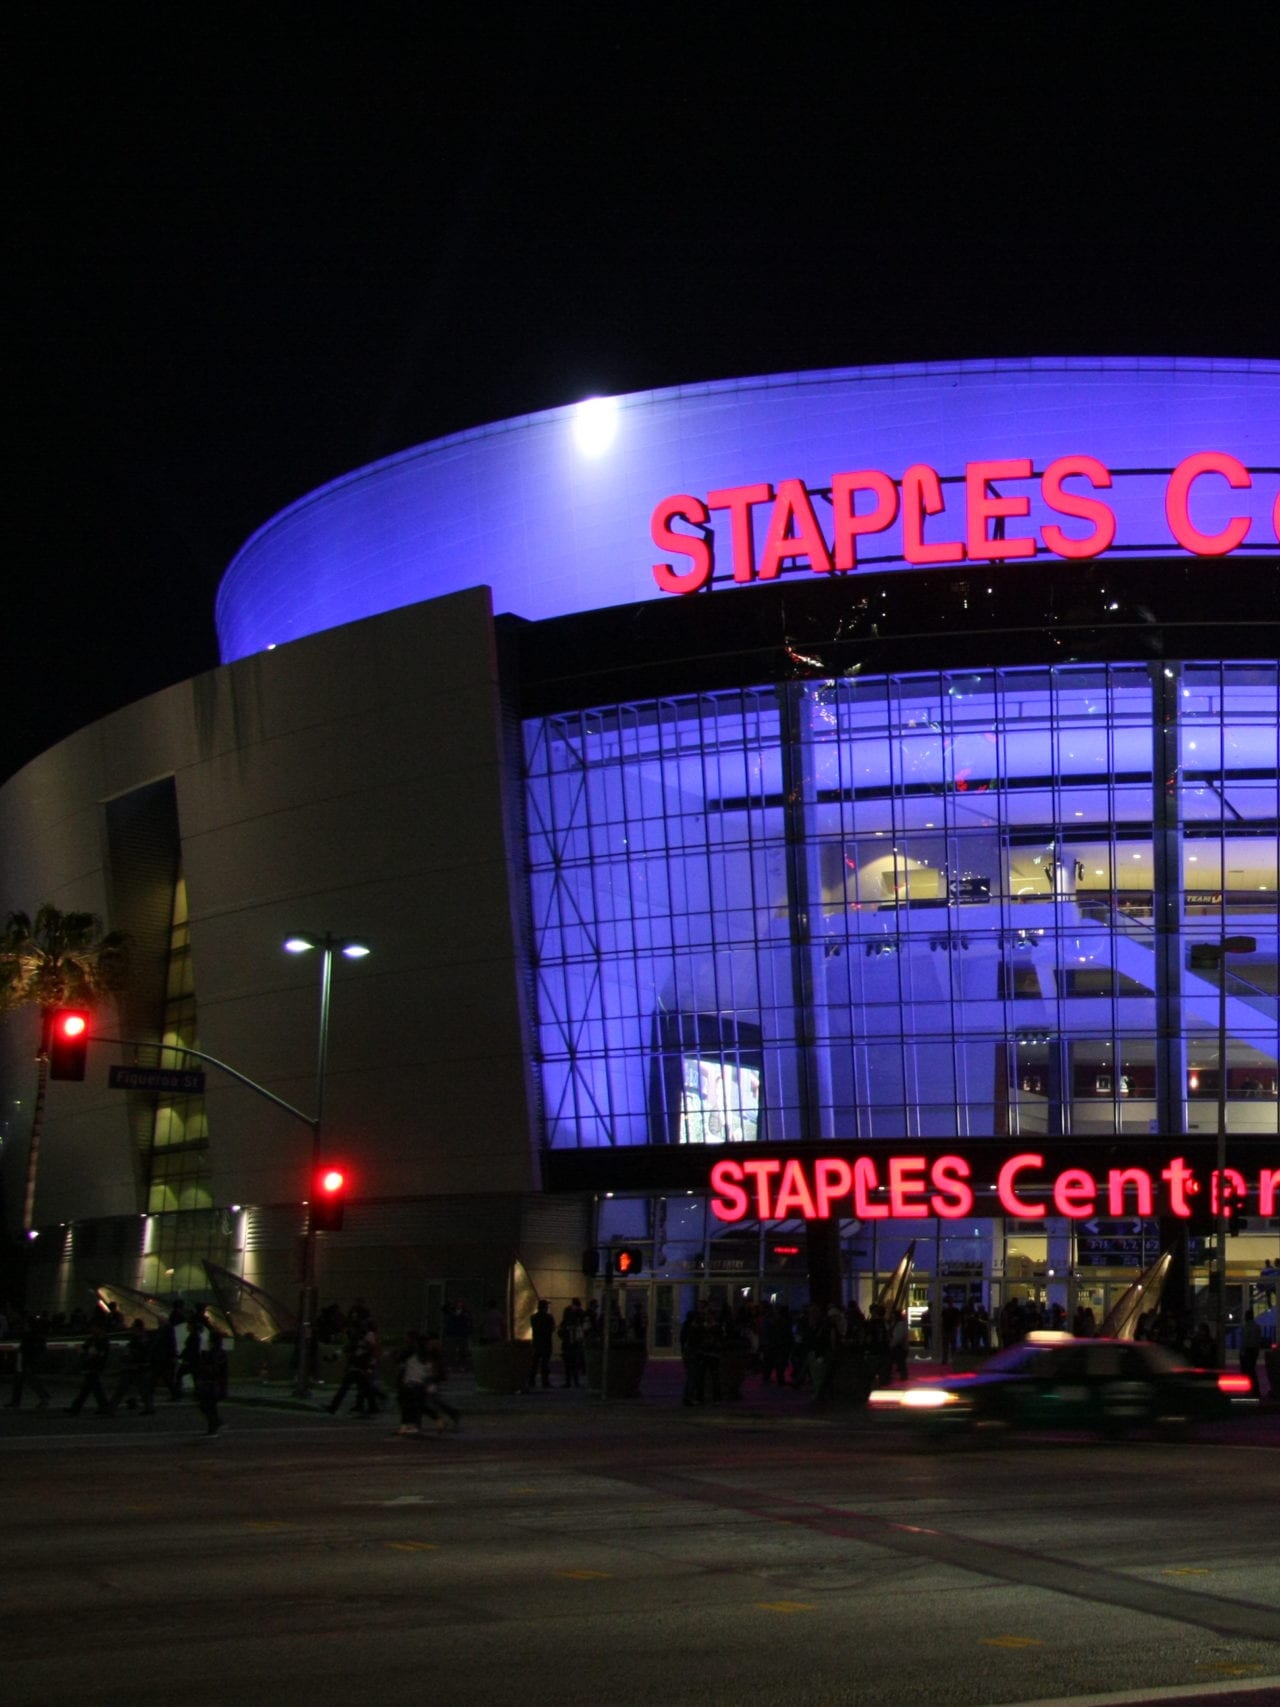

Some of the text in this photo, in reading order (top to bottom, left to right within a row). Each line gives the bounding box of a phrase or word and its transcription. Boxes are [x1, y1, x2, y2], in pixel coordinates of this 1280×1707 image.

[651, 451, 1116, 595] STAPLES
[115, 1070, 199, 1089] Figueroa St
[709, 1154, 974, 1221] STAPLES
